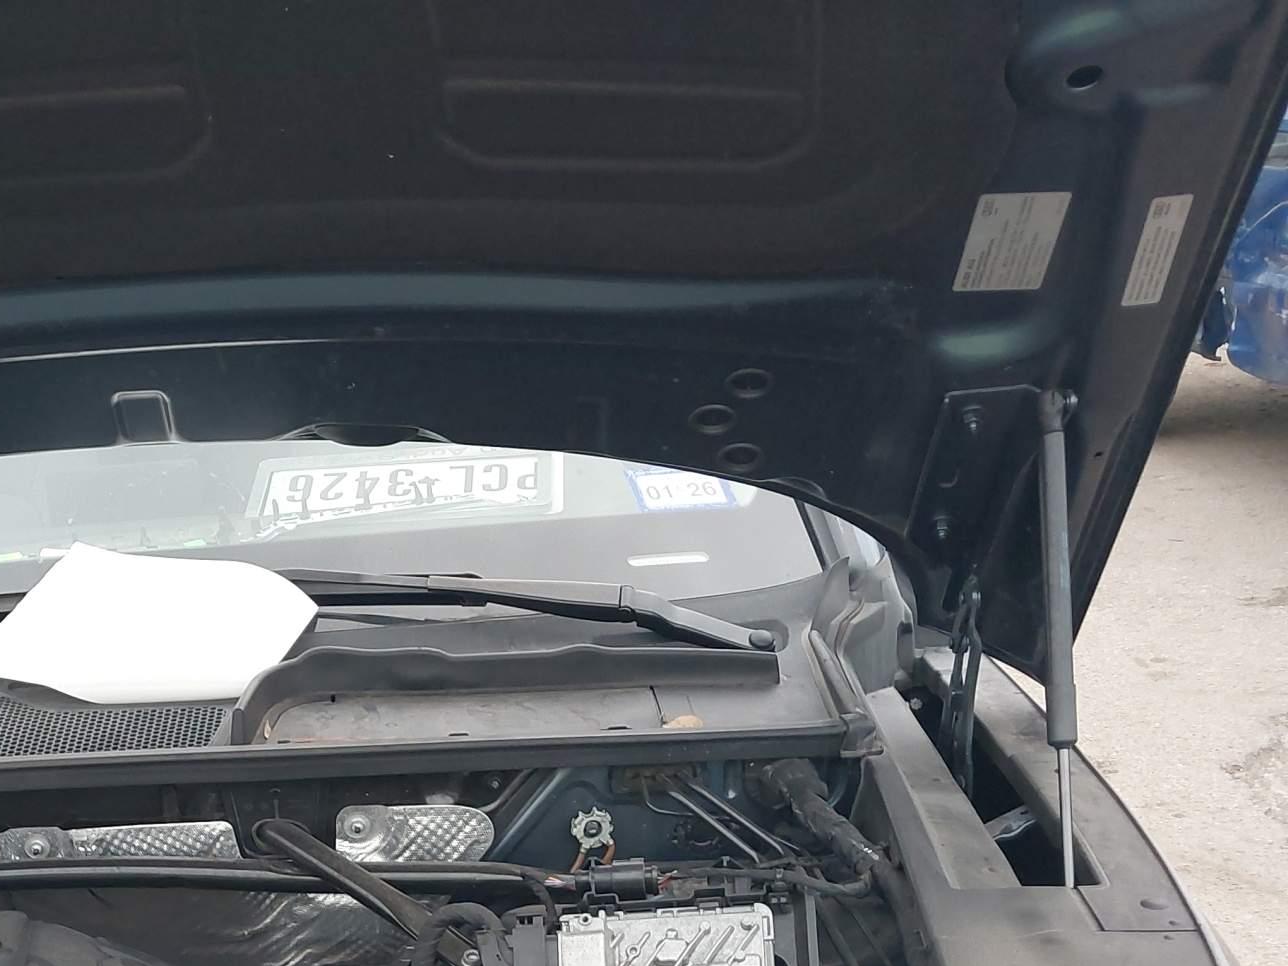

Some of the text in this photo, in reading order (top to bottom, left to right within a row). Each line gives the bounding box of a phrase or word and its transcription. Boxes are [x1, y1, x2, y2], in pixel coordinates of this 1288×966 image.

[287, 460, 539, 503] PCL 3426
[646, 480, 717, 500] 01 26
